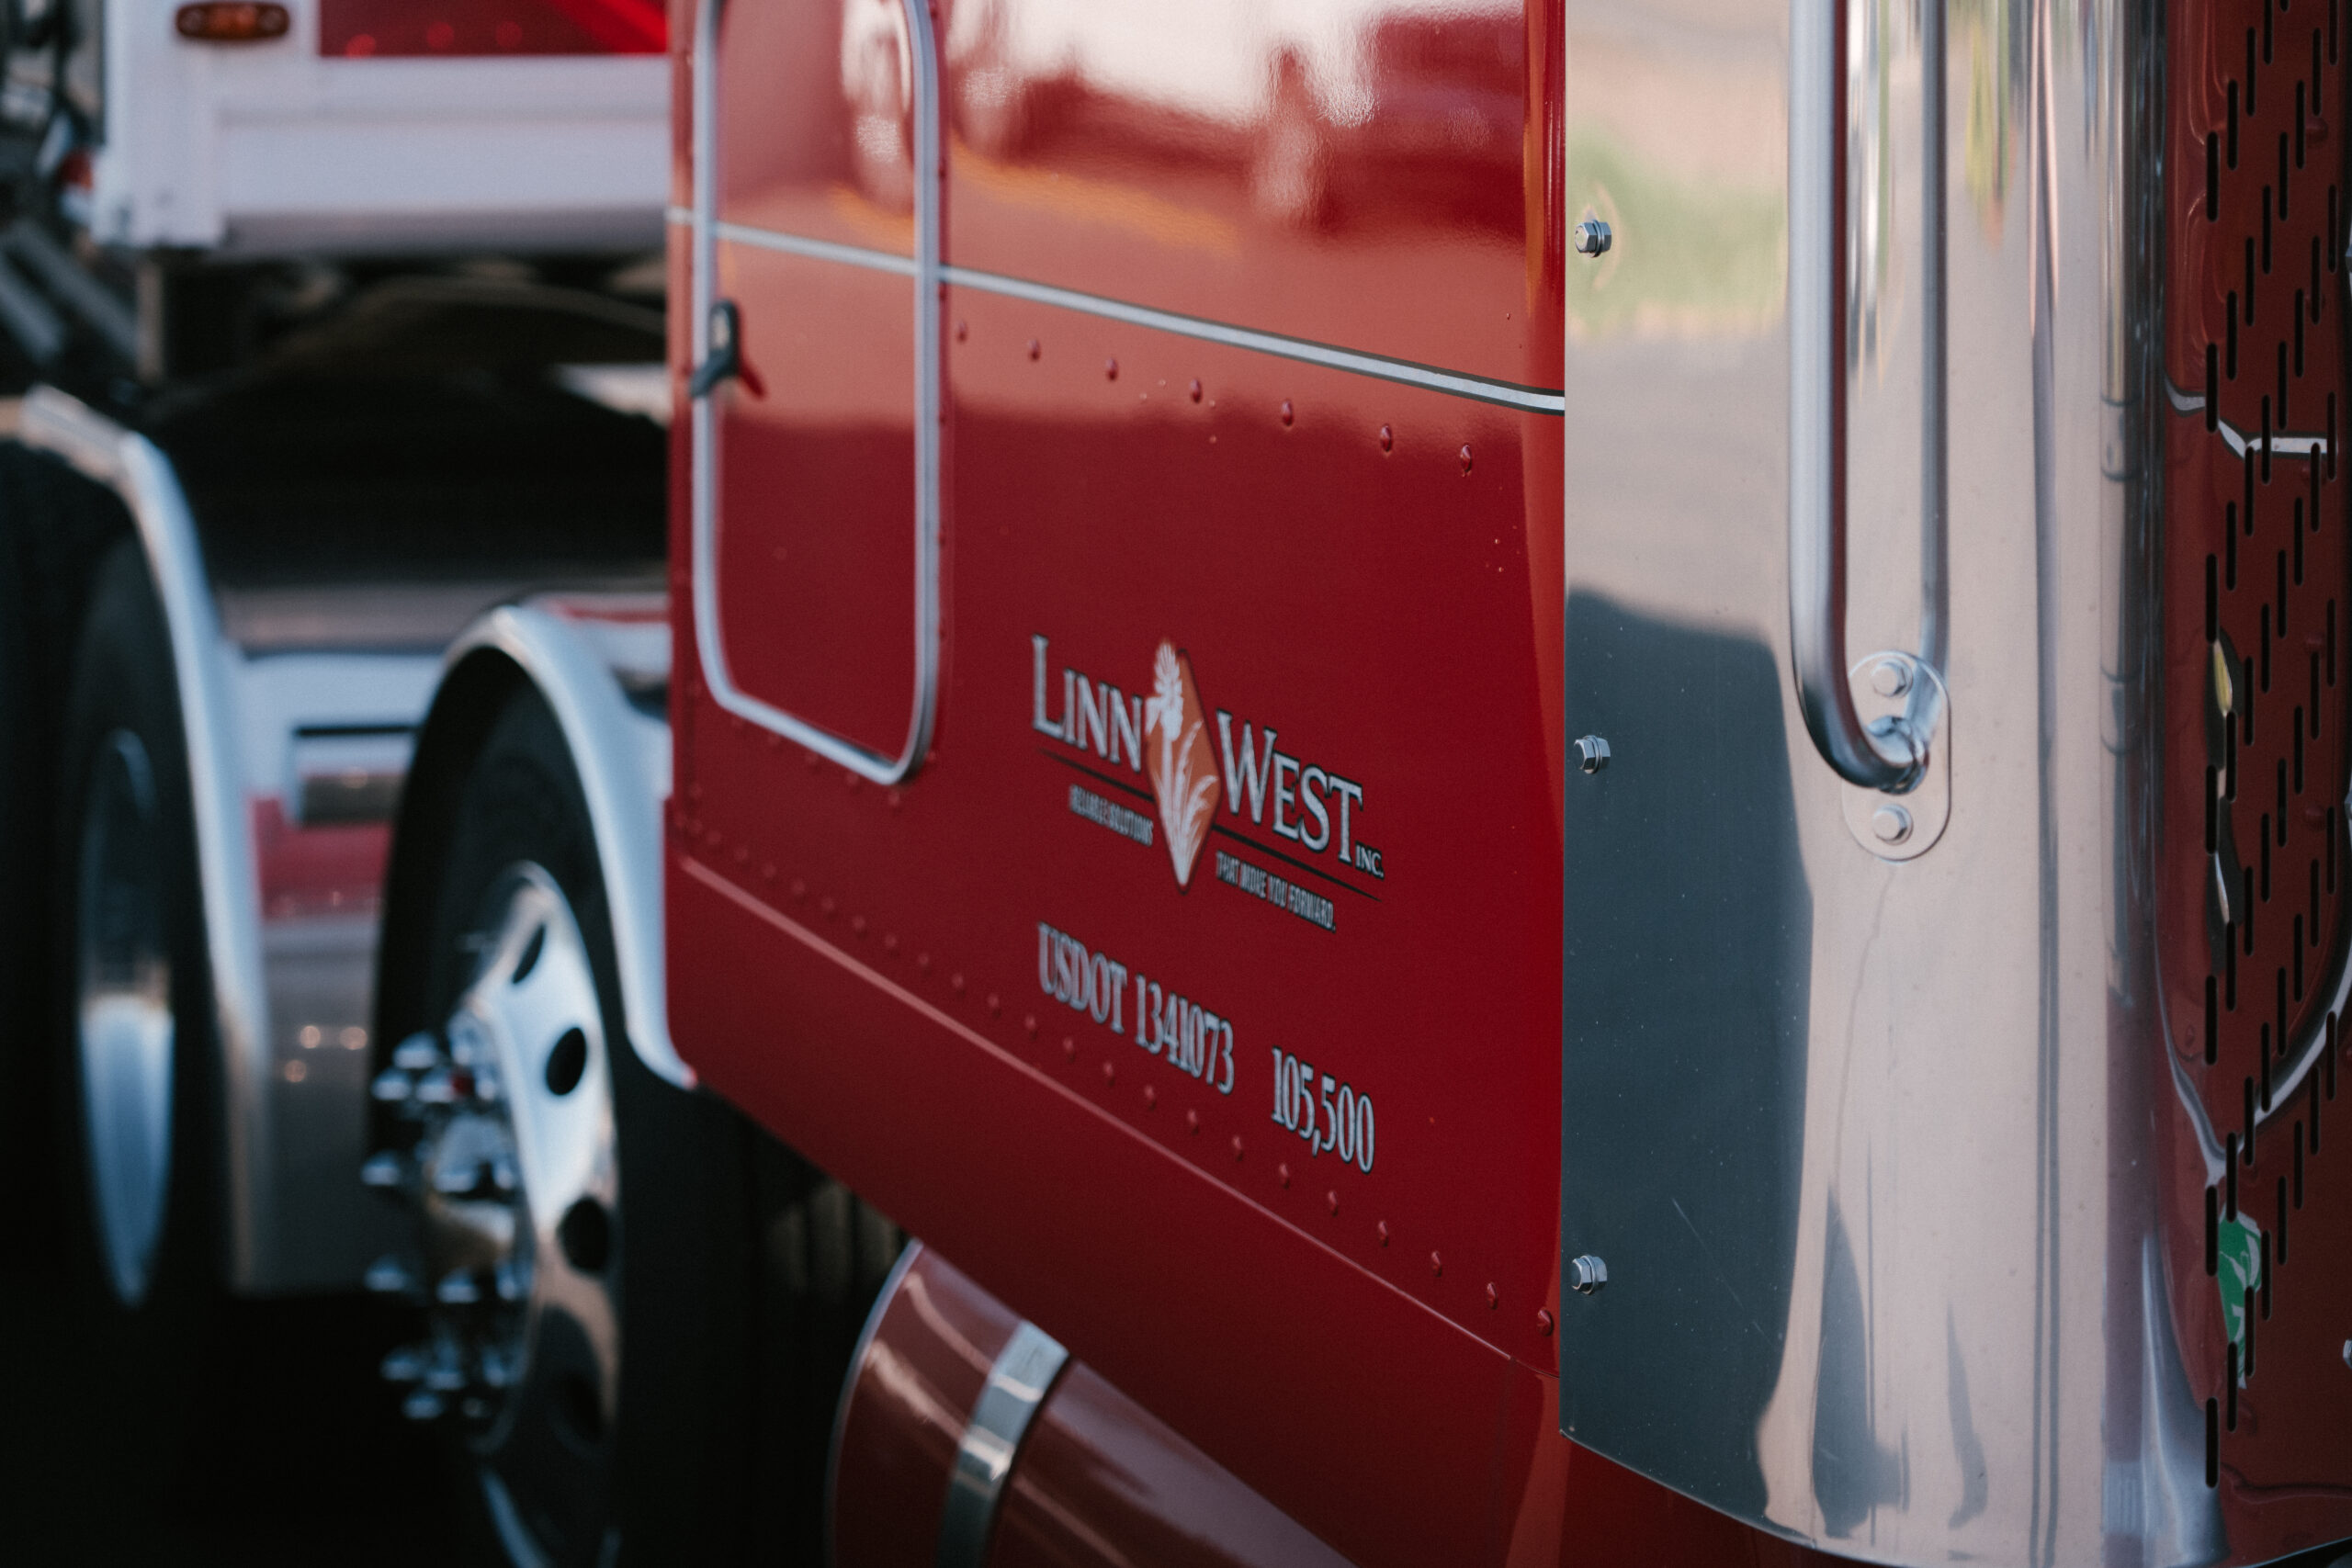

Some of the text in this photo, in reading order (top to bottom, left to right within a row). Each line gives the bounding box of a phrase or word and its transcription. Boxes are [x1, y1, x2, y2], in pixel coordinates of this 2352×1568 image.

[1031, 633, 1143, 773] LINN
[1216, 707, 1363, 864] WEST
[1216, 849, 1240, 886] THAT
[1239, 861, 1268, 899] MOVE
[1267, 872, 1288, 909] YOU
[1038, 920, 1374, 1174] USDOT 1341073 105,500
